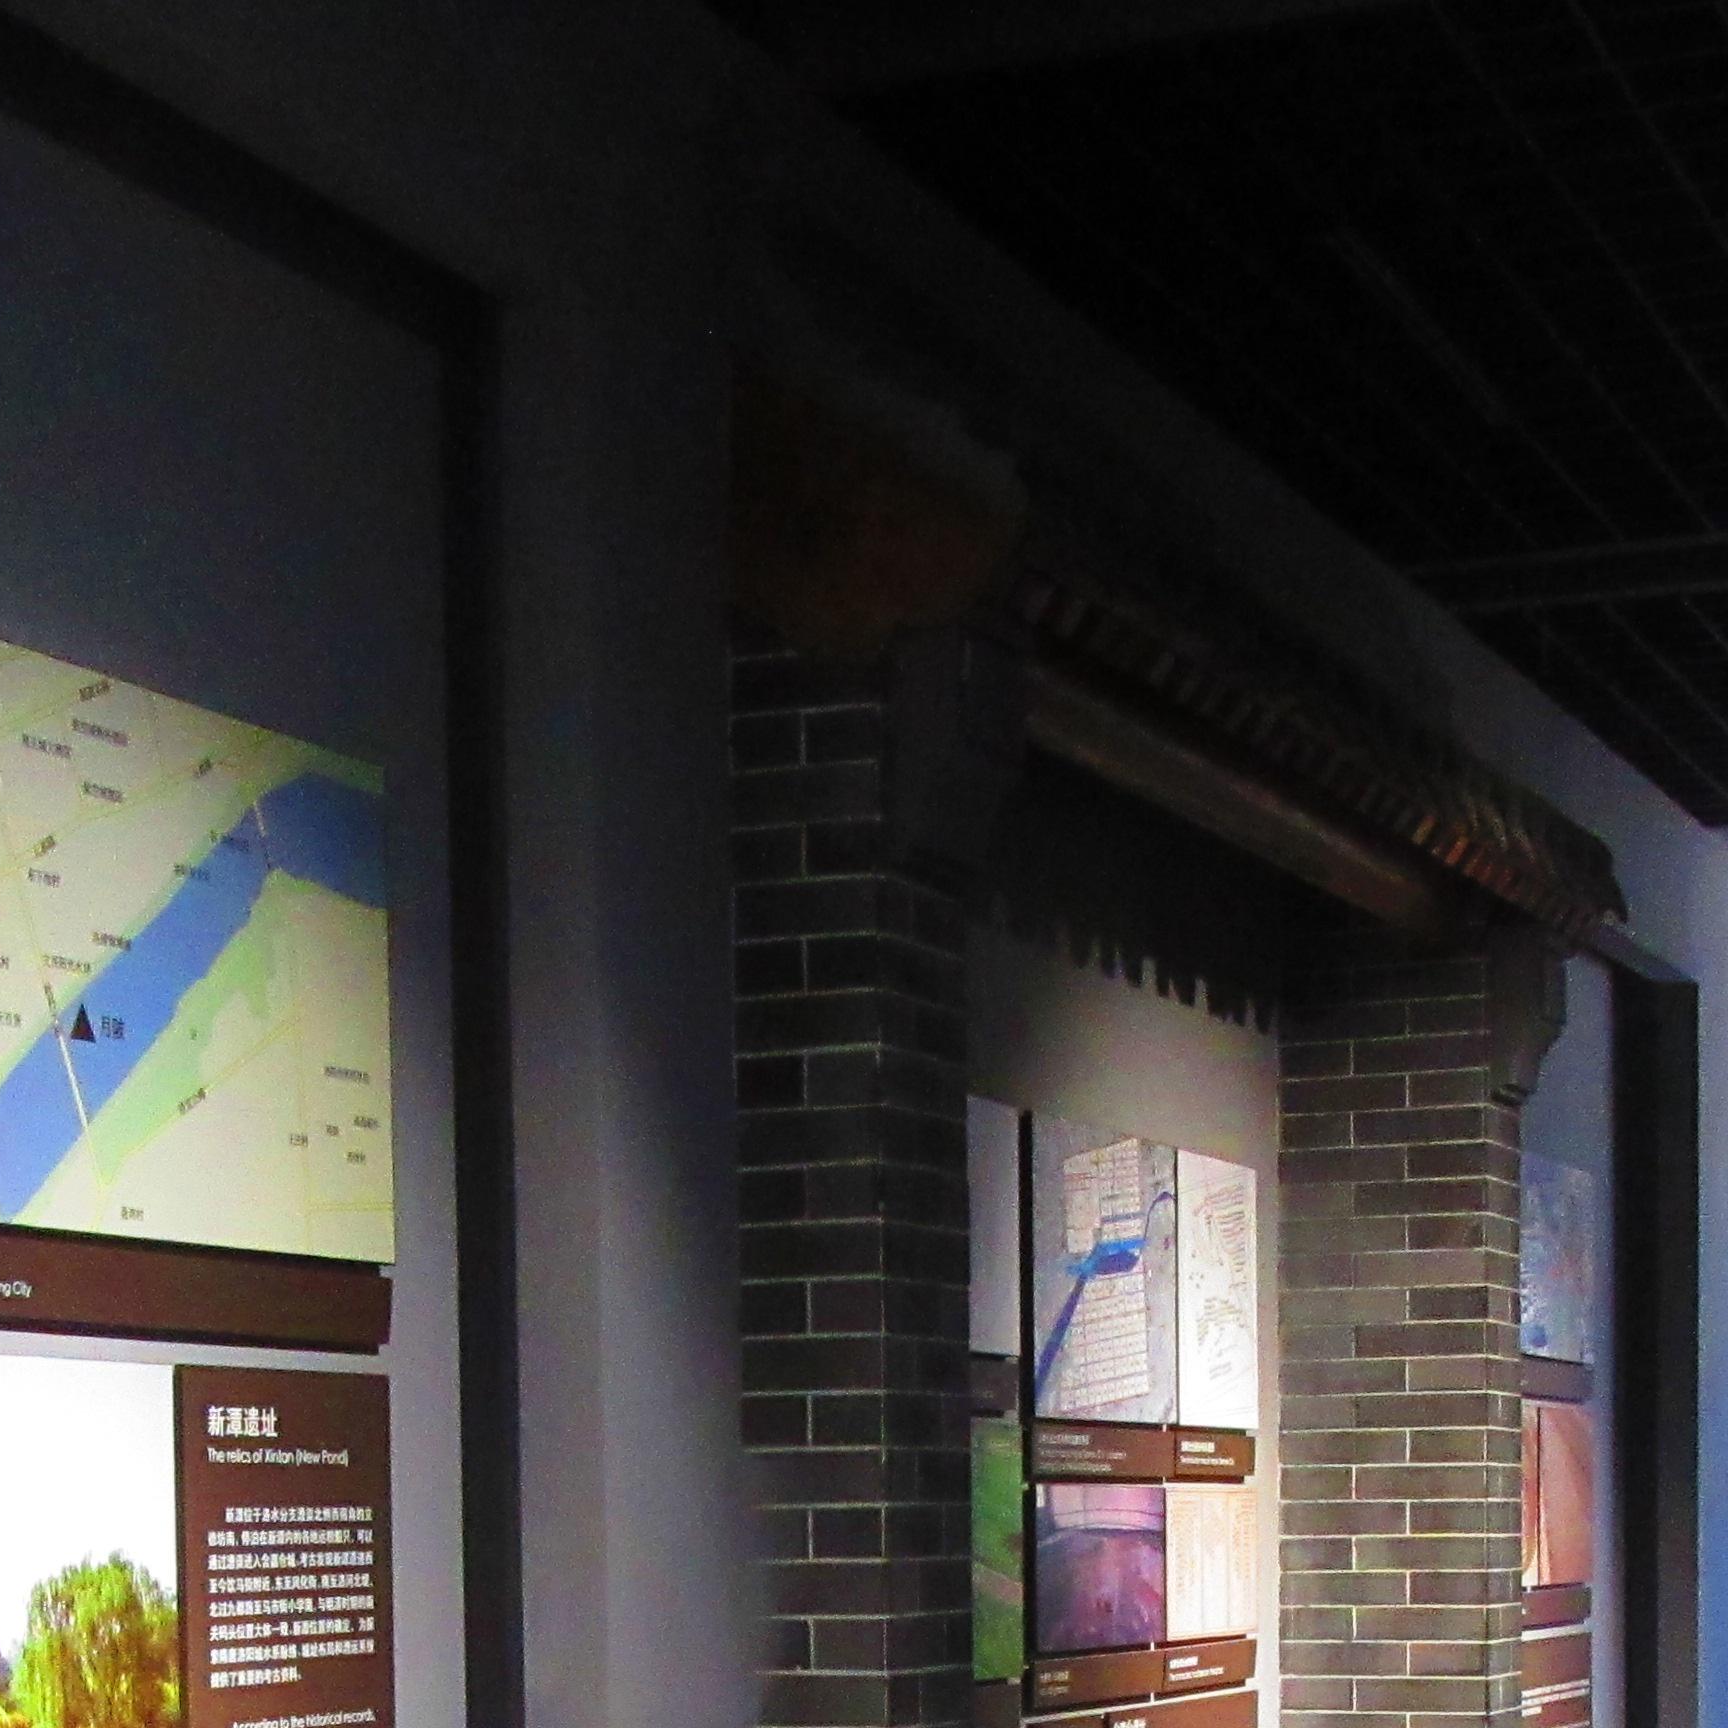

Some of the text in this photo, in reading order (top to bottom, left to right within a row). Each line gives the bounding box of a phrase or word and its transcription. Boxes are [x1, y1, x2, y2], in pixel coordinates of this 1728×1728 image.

[11, 1280, 33, 1298] City
[207, 1406, 278, 1437] 新潭遗址
[206, 1446, 349, 1466] The relics of Xintan (New Pond)
